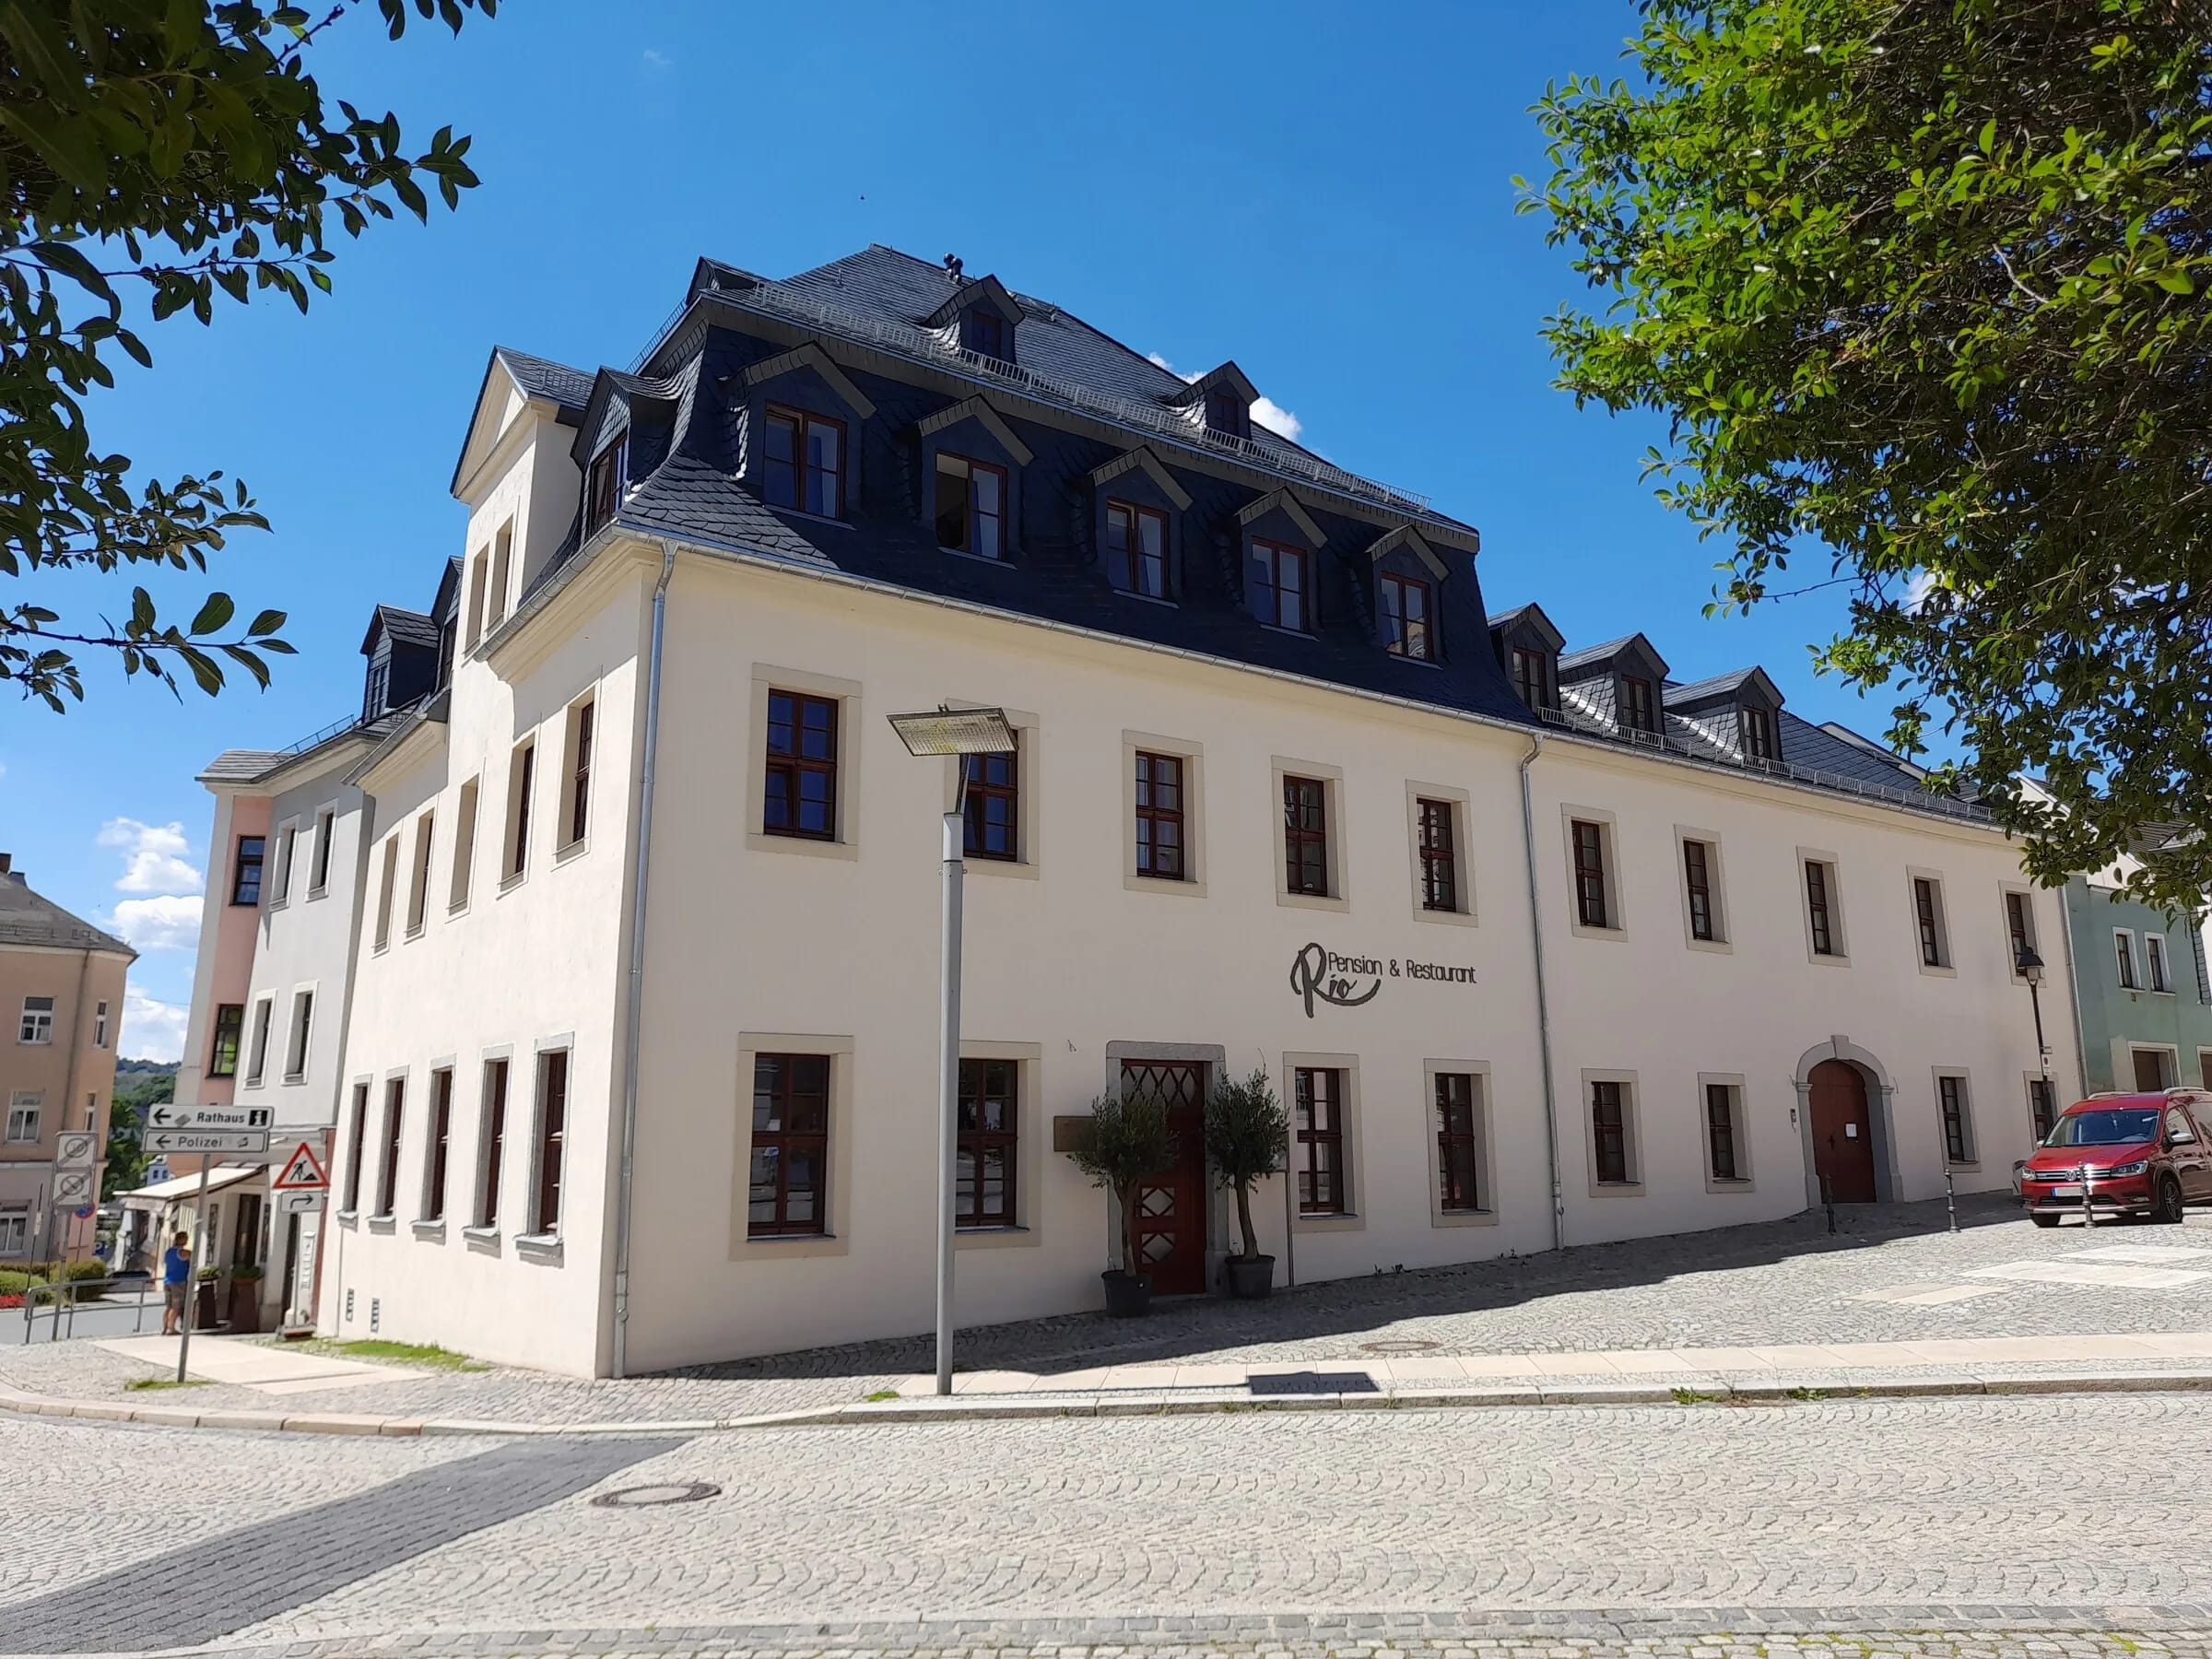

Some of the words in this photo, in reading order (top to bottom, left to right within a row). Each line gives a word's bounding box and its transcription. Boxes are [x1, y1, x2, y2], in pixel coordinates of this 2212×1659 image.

[1328, 952, 1382, 975] Pension
[1390, 959, 1400, 977] &
[1406, 959, 1477, 983] Restaurant
[1290, 942, 1381, 1018] Rio
[196, 1112, 245, 1123] Rathaus
[178, 1136, 222, 1147] Polizei
